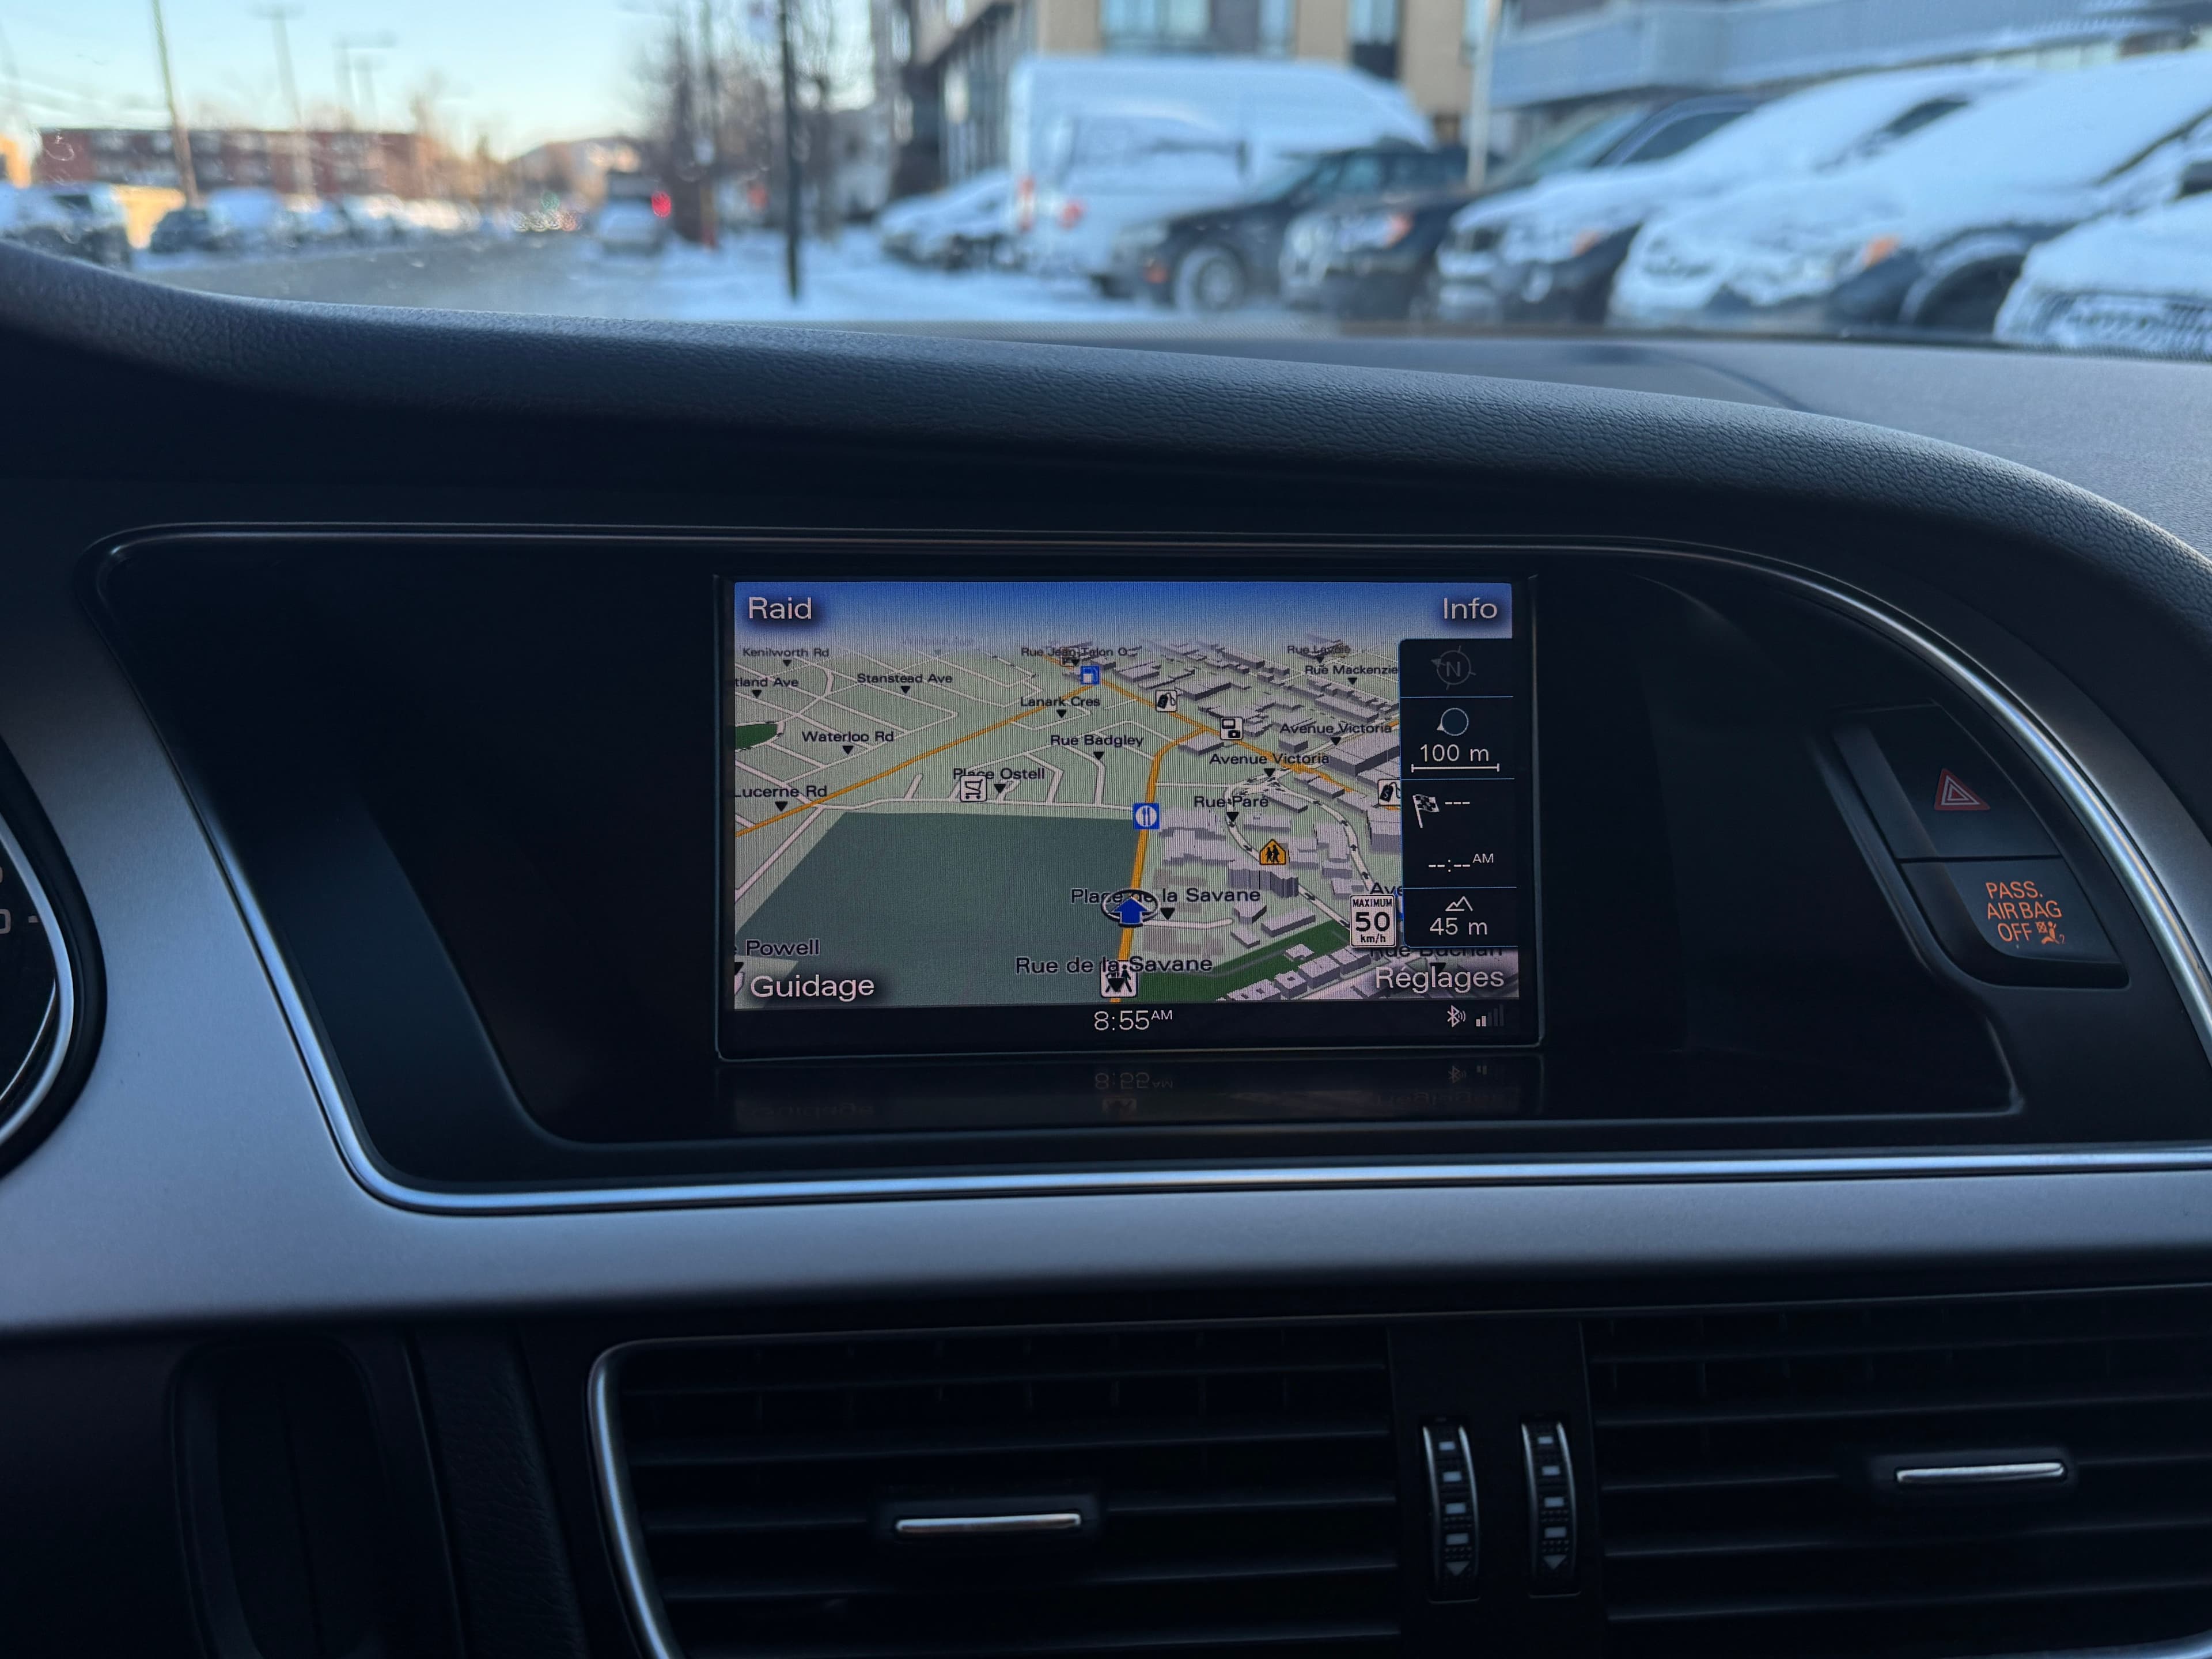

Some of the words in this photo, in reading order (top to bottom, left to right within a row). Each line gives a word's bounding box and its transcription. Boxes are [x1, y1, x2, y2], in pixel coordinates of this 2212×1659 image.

[749, 596, 812, 620] Raid
[1443, 597, 1498, 620] Info
[743, 647, 809, 657] Kenilworth
[813, 647, 830, 657] Rd
[1021, 647, 1044, 657] Rue
[1287, 645, 1310, 654] Rue
[1305, 665, 1328, 675] Rue
[1332, 664, 1398, 675] Mackenzie
[773, 677, 800, 687] Ave
[857, 673, 923, 684] Stanstead
[927, 673, 953, 684] Ave
[1020, 696, 1066, 707] Lanark
[1070, 696, 1101, 707] Cres
[1279, 723, 1335, 734] Avenue
[1338, 722, 1392, 734] Victoria
[801, 730, 870, 743] Waterloo
[874, 730, 895, 742] Rd
[1050, 734, 1080, 746] Rue
[1084, 734, 1144, 748] Badgley
[1210, 753, 1268, 764] Avenue
[1272, 752, 1330, 764] Victoria
[1419, 743, 1460, 763] 100
[1469, 748, 1490, 762] m
[999, 767, 1046, 780] Ostell
[806, 785, 828, 798] Rd
[1194, 796, 1226, 808] Rue
[1232, 795, 1270, 808] Paré
[1162, 888, 1177, 903] la
[1185, 887, 1261, 903] Savane
[1986, 881, 2043, 899] PASS.
[1353, 898, 1393, 908] MAXIMUM
[1355, 911, 1391, 933] 50
[1429, 916, 1459, 935] 45
[1468, 921, 1488, 935] m
[1360, 933, 1387, 943] km/h
[1998, 923, 2032, 942] OFF
[746, 938, 820, 956] Powell
[1016, 956, 1059, 974] Rue
[1066, 956, 1094, 974] de
[1102, 956, 1119, 973] la
[1128, 955, 1213, 972] Savane
[1376, 965, 1505, 994] Réglages
[750, 974, 875, 1002] Guidage
